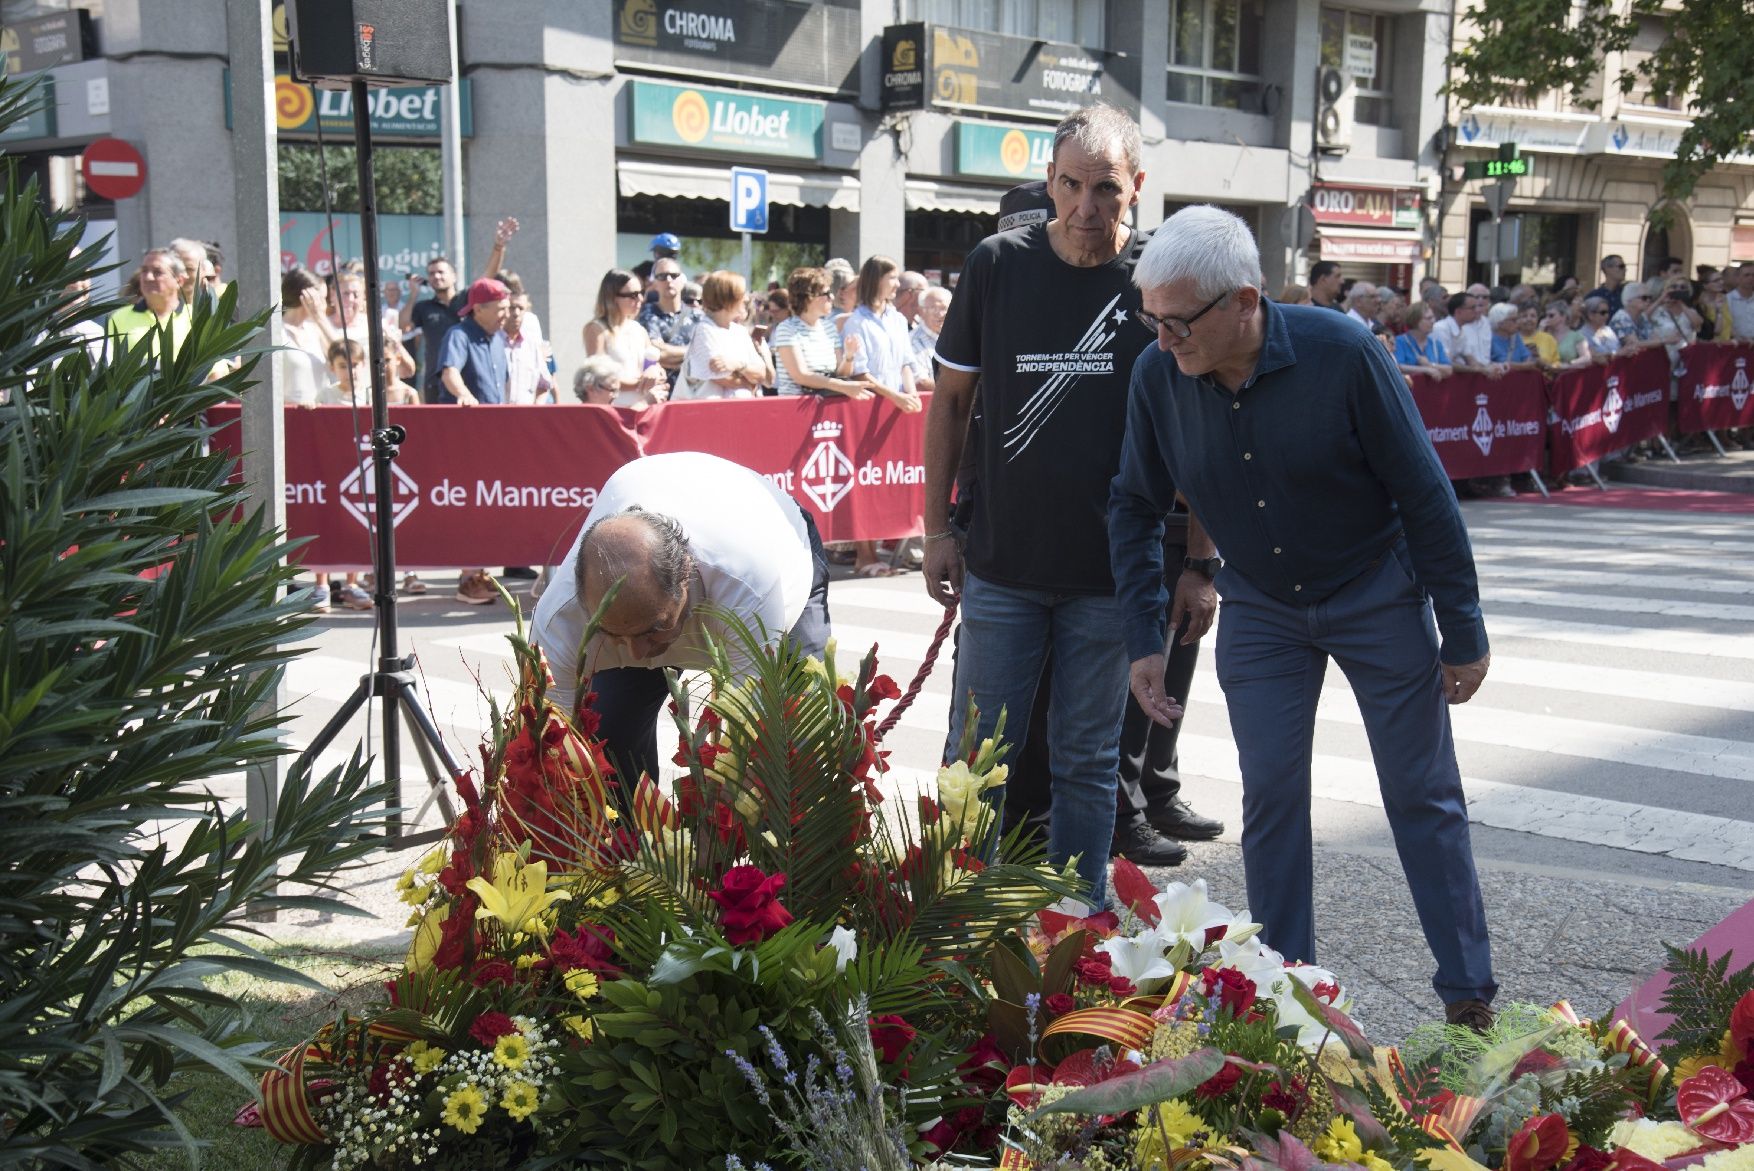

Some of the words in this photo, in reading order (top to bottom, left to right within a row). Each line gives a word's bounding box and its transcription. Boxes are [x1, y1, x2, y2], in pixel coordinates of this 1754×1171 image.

[664, 9, 736, 42] CHROMA
[885, 71, 922, 88] CHROMA
[713, 101, 790, 139] Llobet
[1487, 160, 1525, 175] 11:46
[736, 174, 762, 225] P
[1019, 212, 1042, 221] POLICIA
[1015, 353, 1064, 361] TORNEM-HI
[1081, 351, 1114, 361] VÈNCER
[1016, 360, 1115, 373] INDEPENDÈNCIA
[1494, 419, 1506, 437] de
[858, 459, 882, 486] de
[430, 478, 467, 507] de
[475, 479, 600, 508] Manresa
